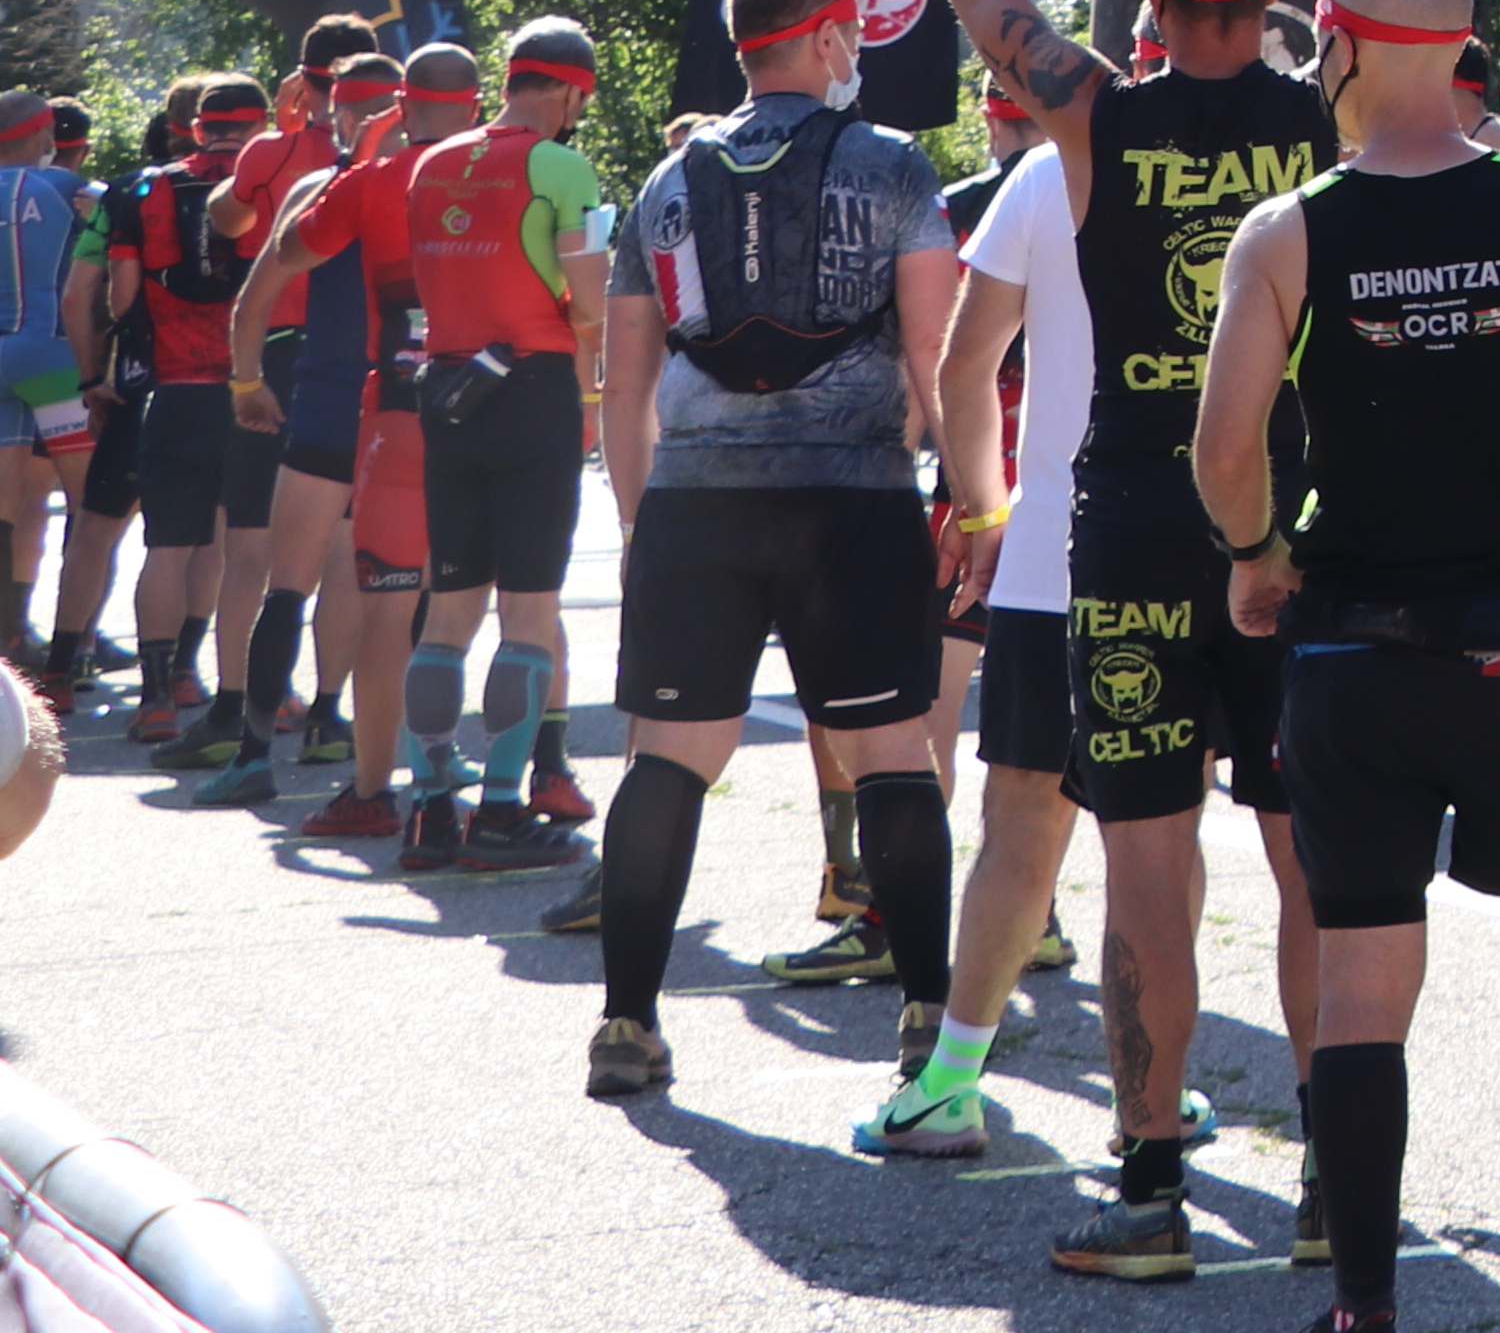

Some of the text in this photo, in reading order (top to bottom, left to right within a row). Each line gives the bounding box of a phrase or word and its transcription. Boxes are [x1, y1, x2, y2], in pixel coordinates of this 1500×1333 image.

[1122, 140, 1317, 208] TEAM
[1162, 218, 1207, 251] CELTIC
[1404, 311, 1469, 338] OCR
[1073, 597, 1192, 640] TEAM
[1089, 718, 1195, 763] CELTIC
